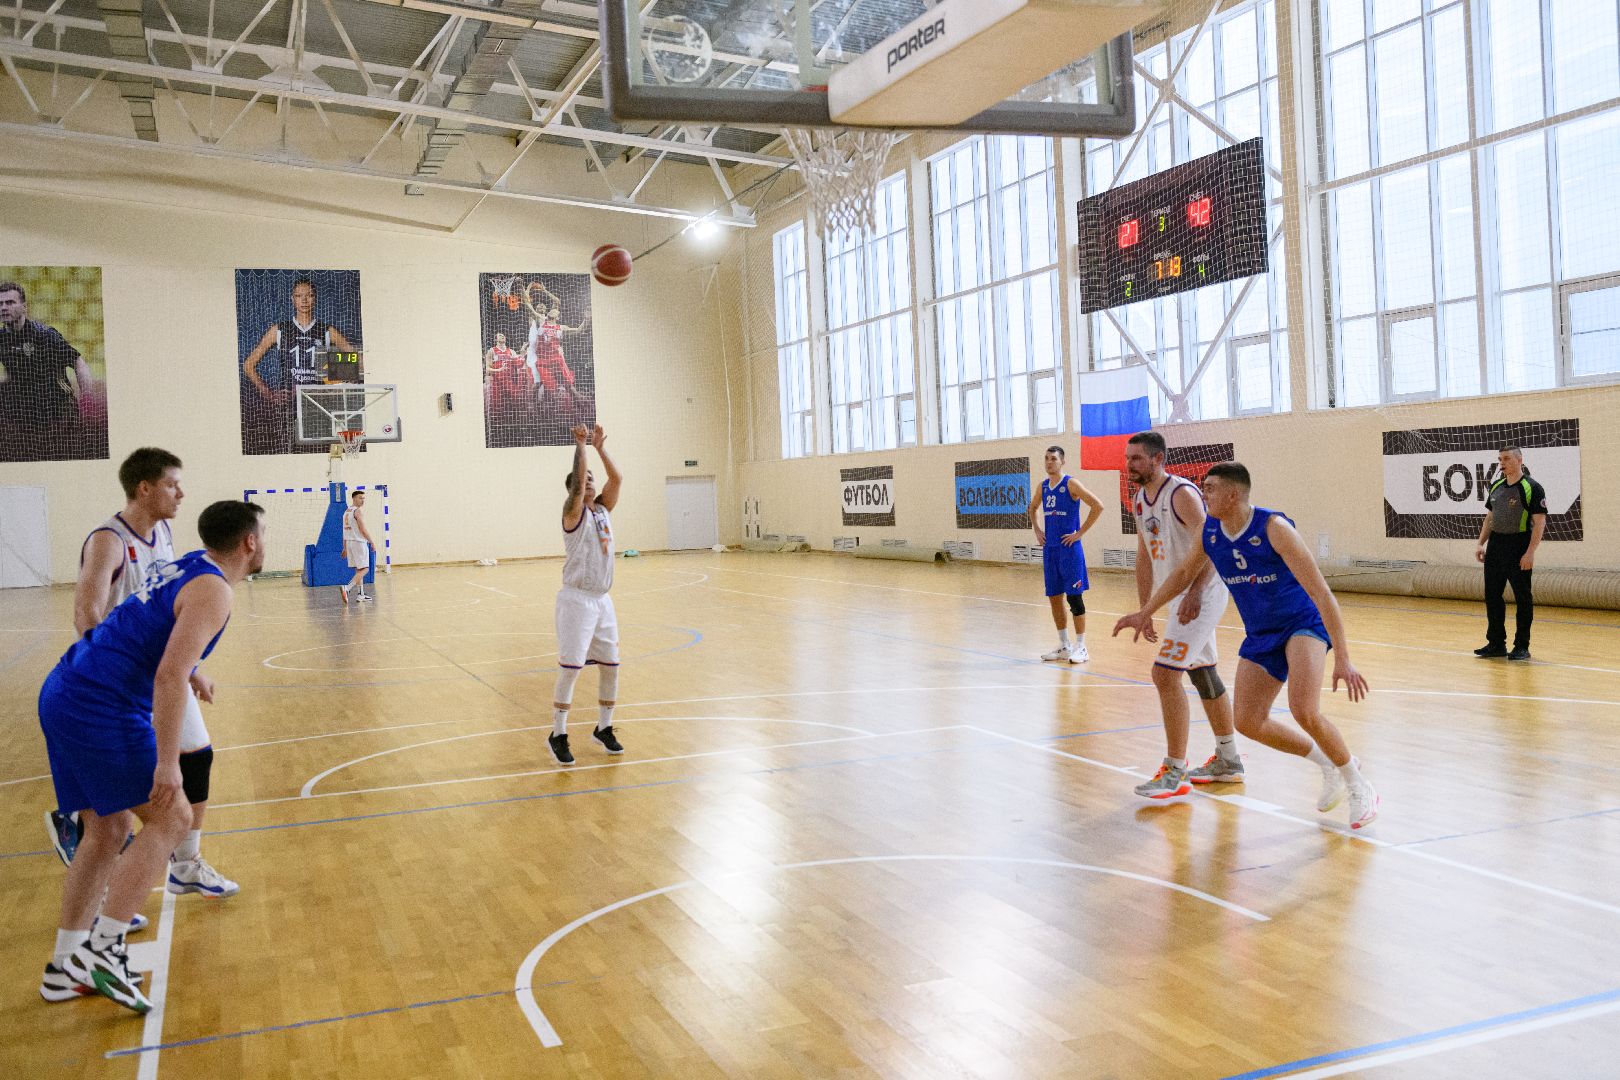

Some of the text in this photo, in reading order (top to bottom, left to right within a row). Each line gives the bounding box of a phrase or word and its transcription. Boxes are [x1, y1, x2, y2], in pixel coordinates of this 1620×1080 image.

[1159, 216, 1165, 232] 3
[1189, 198, 1210, 227] 42
[1120, 219, 1139, 248] 27
[1125, 281, 1132, 297] 2
[843, 483, 890, 506] ФУТБОЛ
[958, 481, 1027, 507] ВОЛЕЙБОЛ
[1045, 495, 1057, 508] 23
[1232, 548, 1248, 570] 5
[1158, 638, 1189, 662] 23
